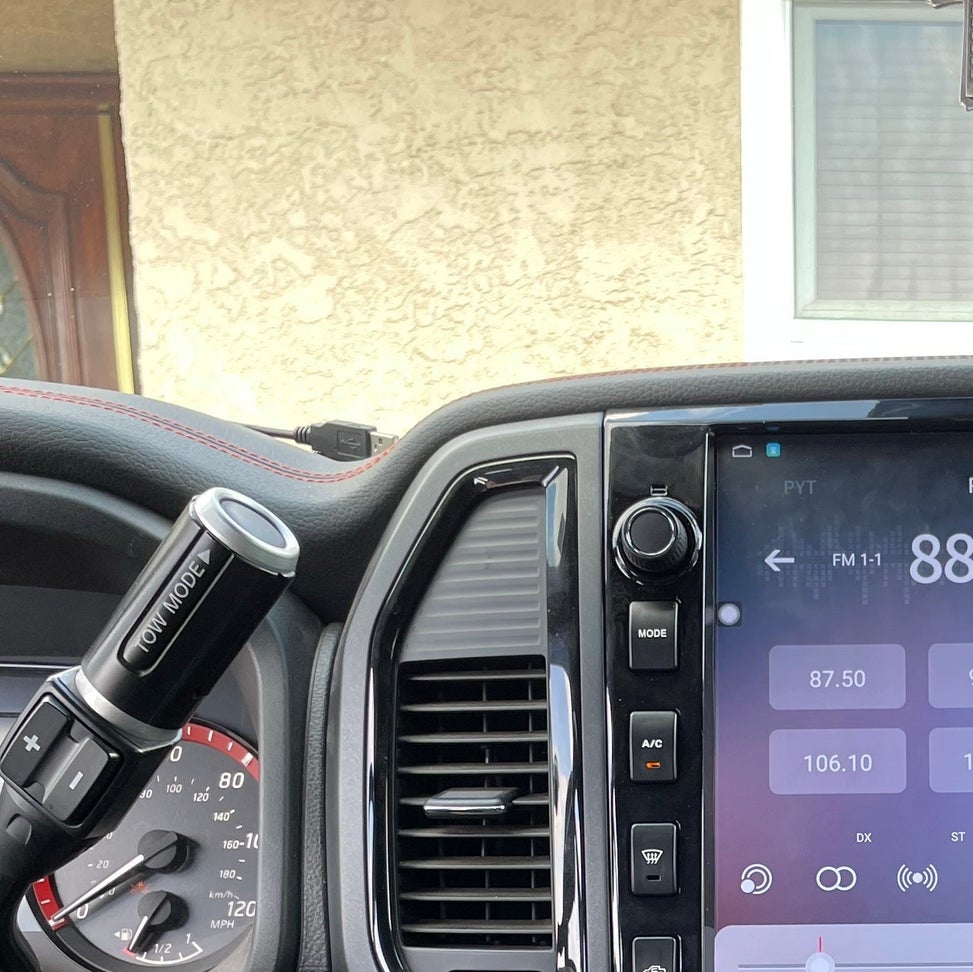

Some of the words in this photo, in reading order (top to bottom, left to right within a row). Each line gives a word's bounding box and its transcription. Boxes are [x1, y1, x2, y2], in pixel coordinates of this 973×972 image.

[783, 480, 817, 495] PYT
[832, 553, 857, 567] FM
[859, 553, 882, 567] 1-1
[135, 612, 168, 653] TOW
[163, 561, 205, 614] MODE
[638, 628, 667, 639] MODE
[808, 669, 867, 689] 87.50
[641, 738, 663, 749] A/C
[803, 753, 873, 773] 106.10
[218, 771, 245, 789] 80
[166, 783, 183, 794] 100
[193, 792, 210, 803] 120
[213, 812, 231, 822] 140
[856, 832, 872, 844] DX
[950, 831, 966, 843] ST
[223, 839, 239, 850] 160
[96, 860, 110, 869] 20
[219, 869, 236, 879] 180
[208, 890, 234, 900] km/h
[76, 902, 89, 919] 0
[227, 901, 257, 918] 120
[210, 919, 235, 930] MPH
[185, 933, 192, 945] 1
[154, 943, 172, 954] 1/2
